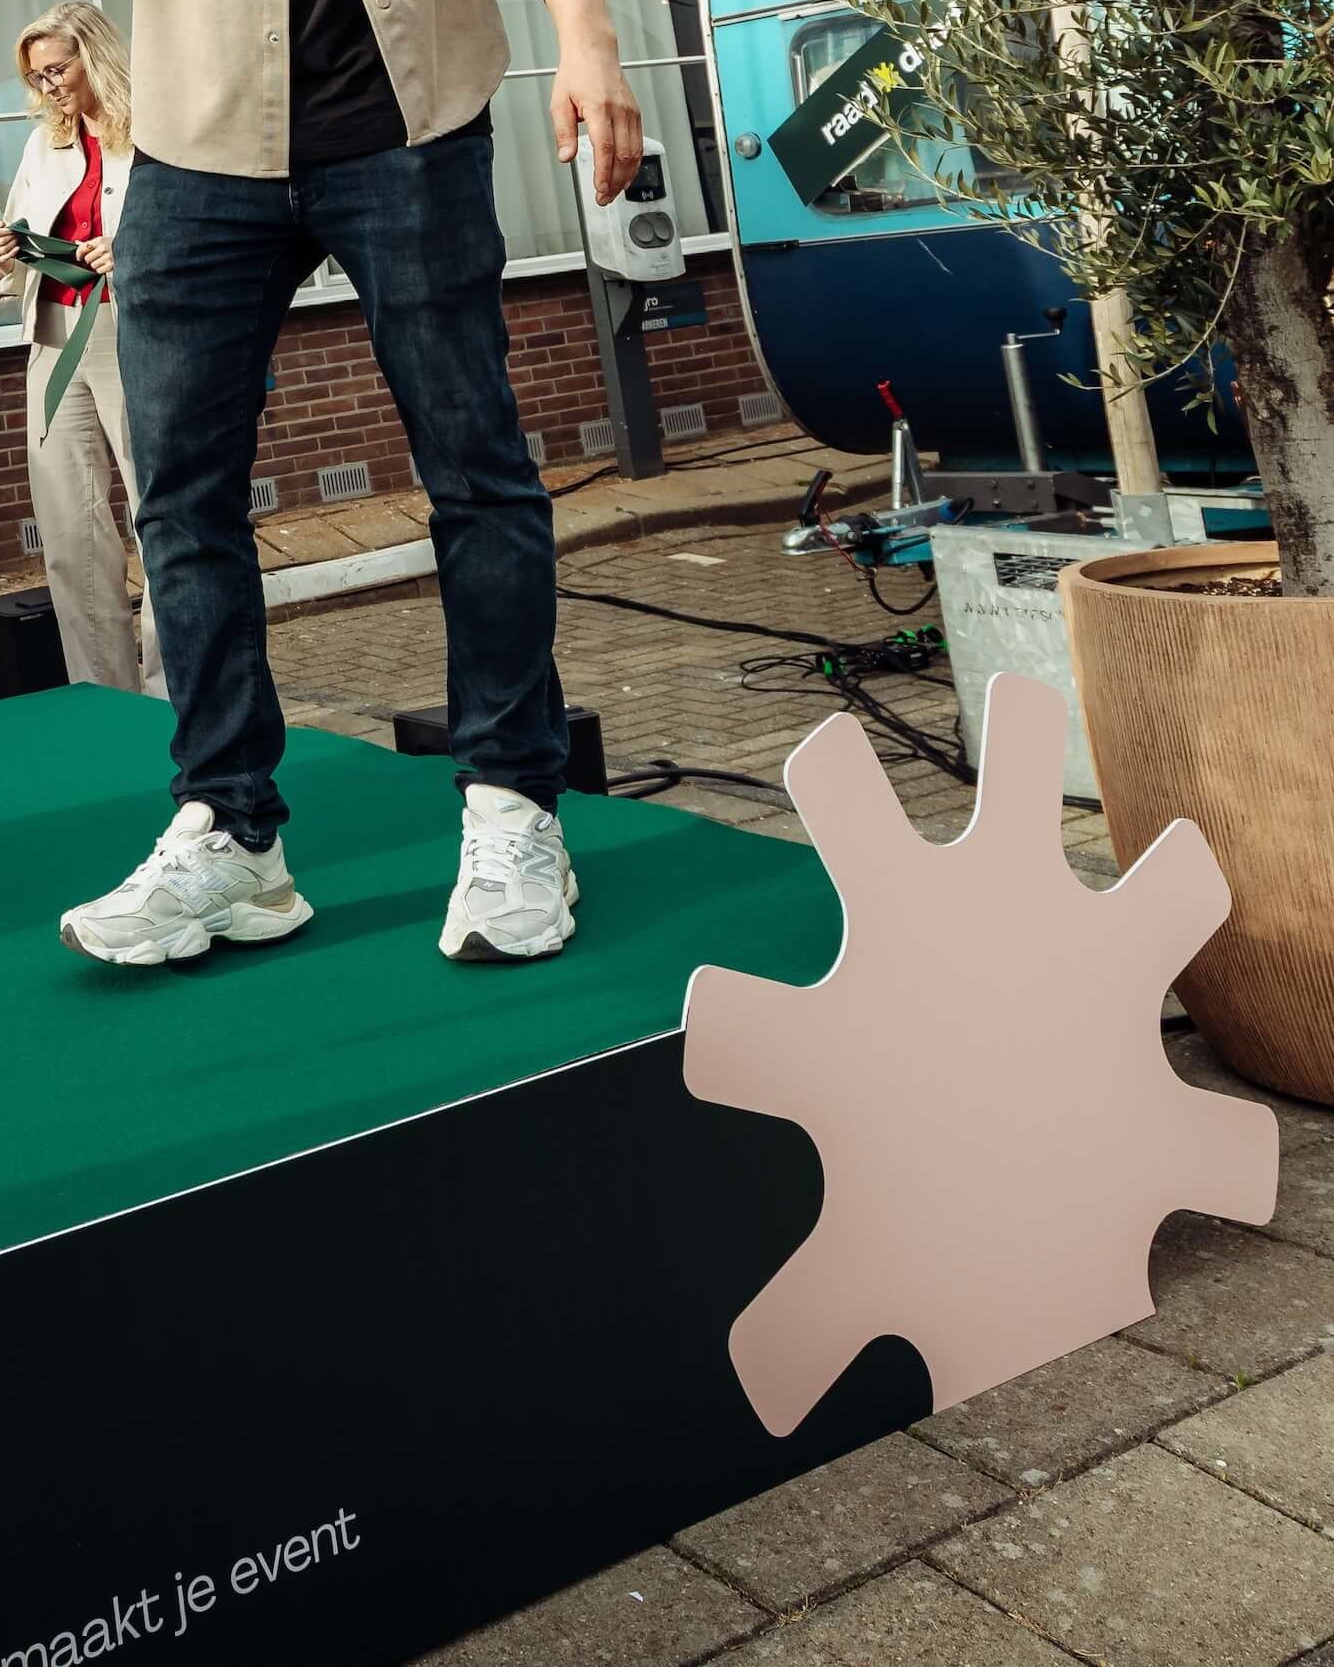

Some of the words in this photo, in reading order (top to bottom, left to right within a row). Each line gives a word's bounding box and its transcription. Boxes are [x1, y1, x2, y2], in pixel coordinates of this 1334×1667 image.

[821, 80, 880, 146] raad
[1, 1589, 164, 1667] maakt
[175, 1571, 217, 1636] je
[230, 1507, 361, 1595] event
